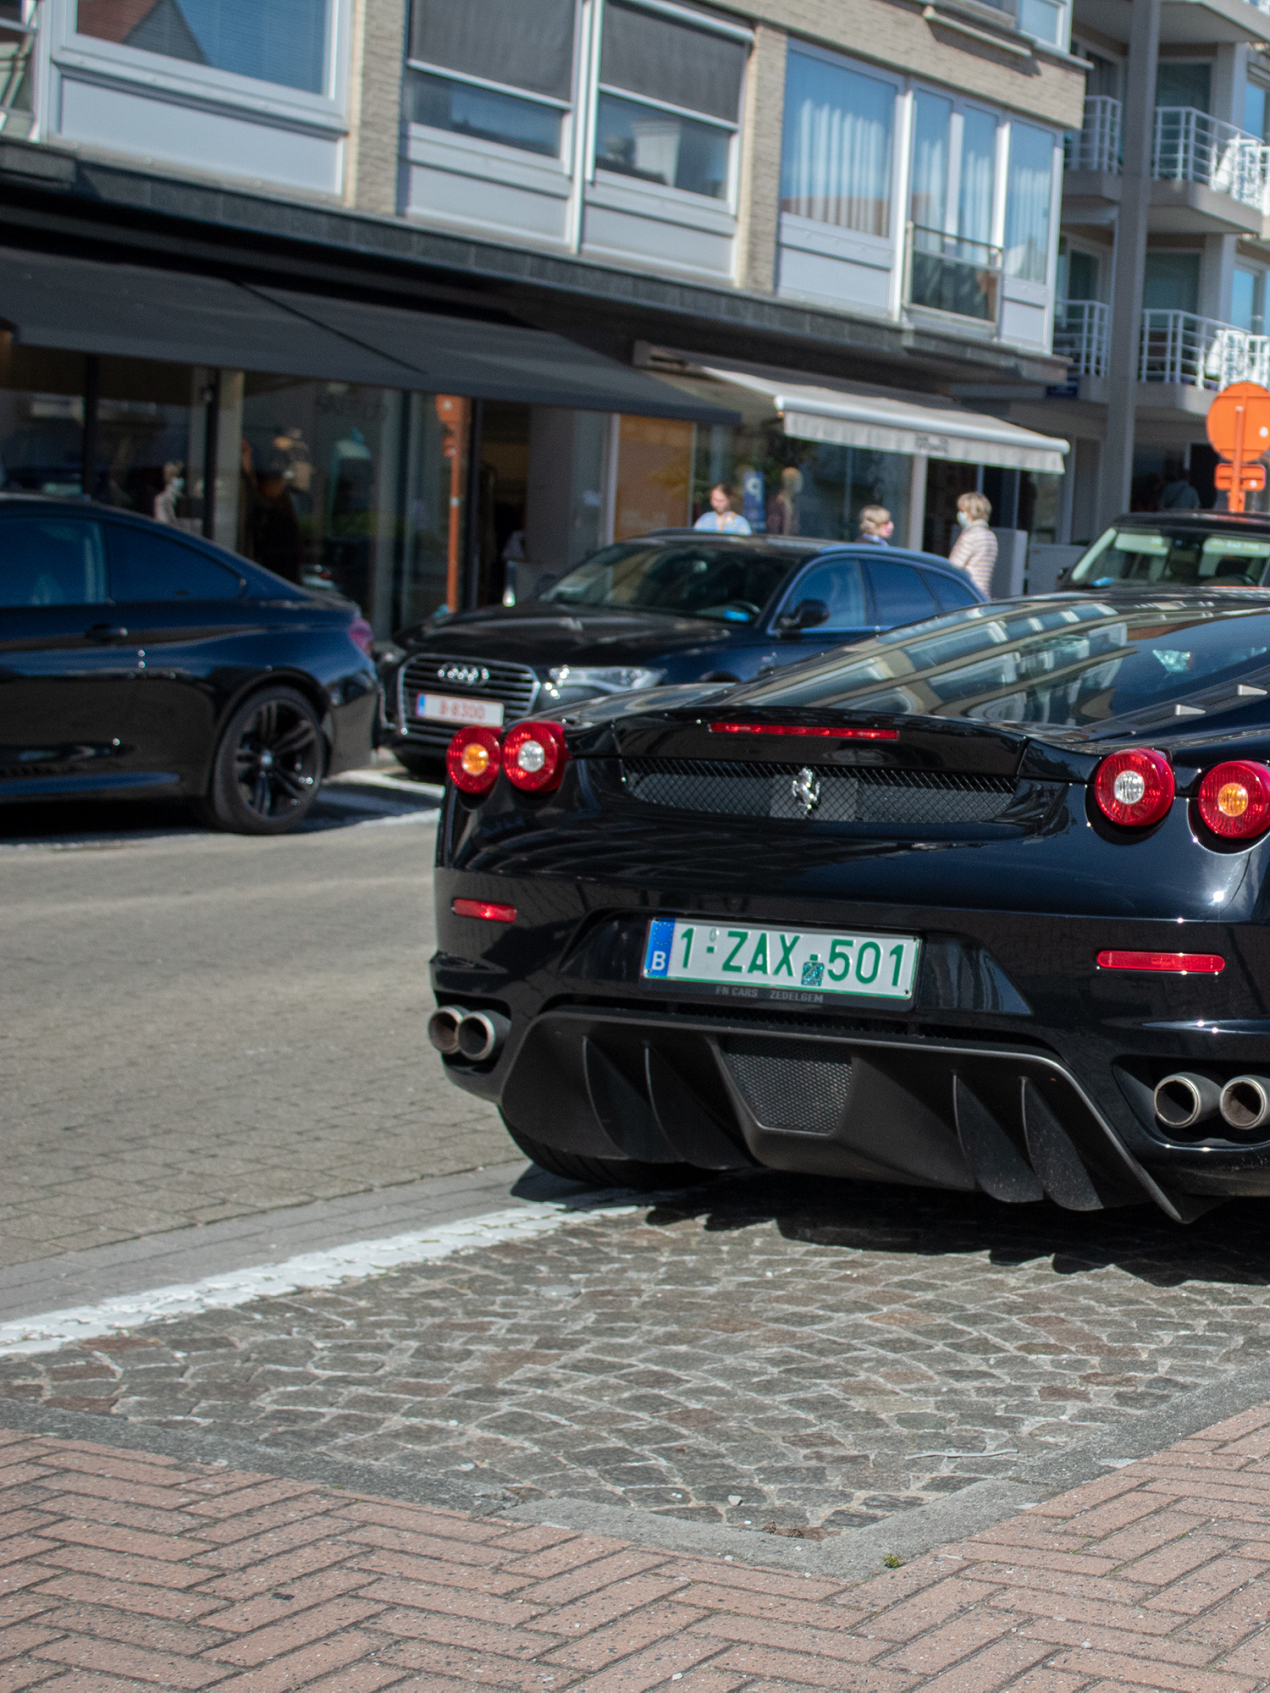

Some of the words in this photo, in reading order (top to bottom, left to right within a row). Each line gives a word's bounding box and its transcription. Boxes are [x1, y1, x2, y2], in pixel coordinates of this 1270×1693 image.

[651, 950, 667, 971] B
[732, 987, 758, 998] CARS
[769, 990, 824, 1003] ZEDELGEM
